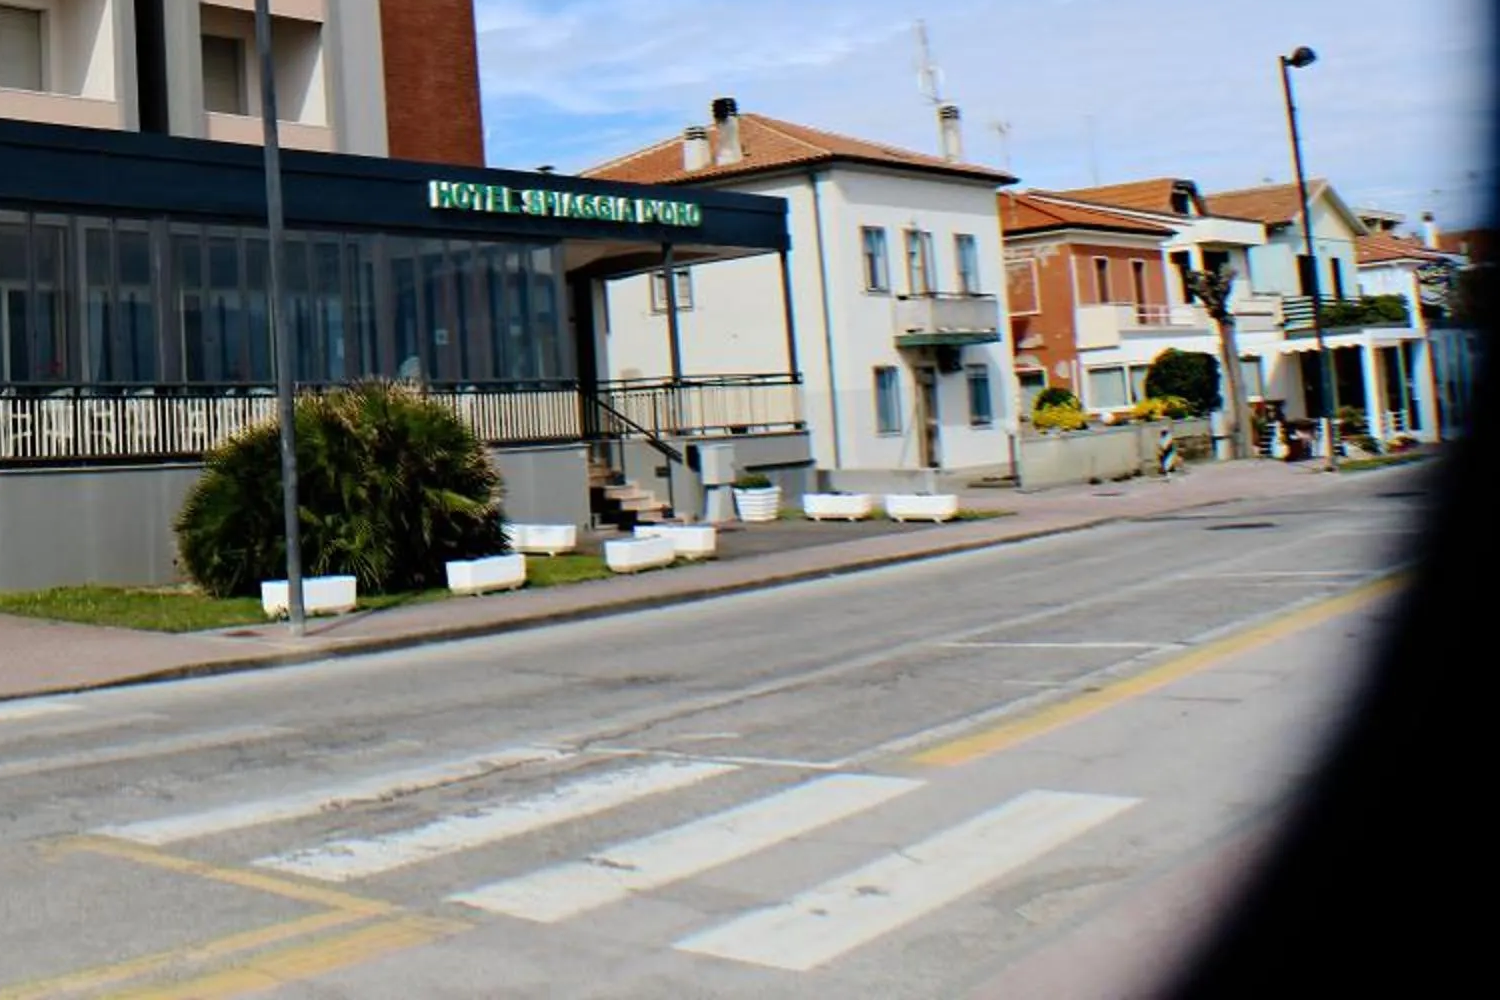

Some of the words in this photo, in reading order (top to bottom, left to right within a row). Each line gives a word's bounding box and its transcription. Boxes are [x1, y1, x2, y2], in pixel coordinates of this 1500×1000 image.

[429, 180, 518, 213] HOTEL
[521, 189, 634, 222] SPIAGGIA
[635, 199, 702, 227] D'ORO
